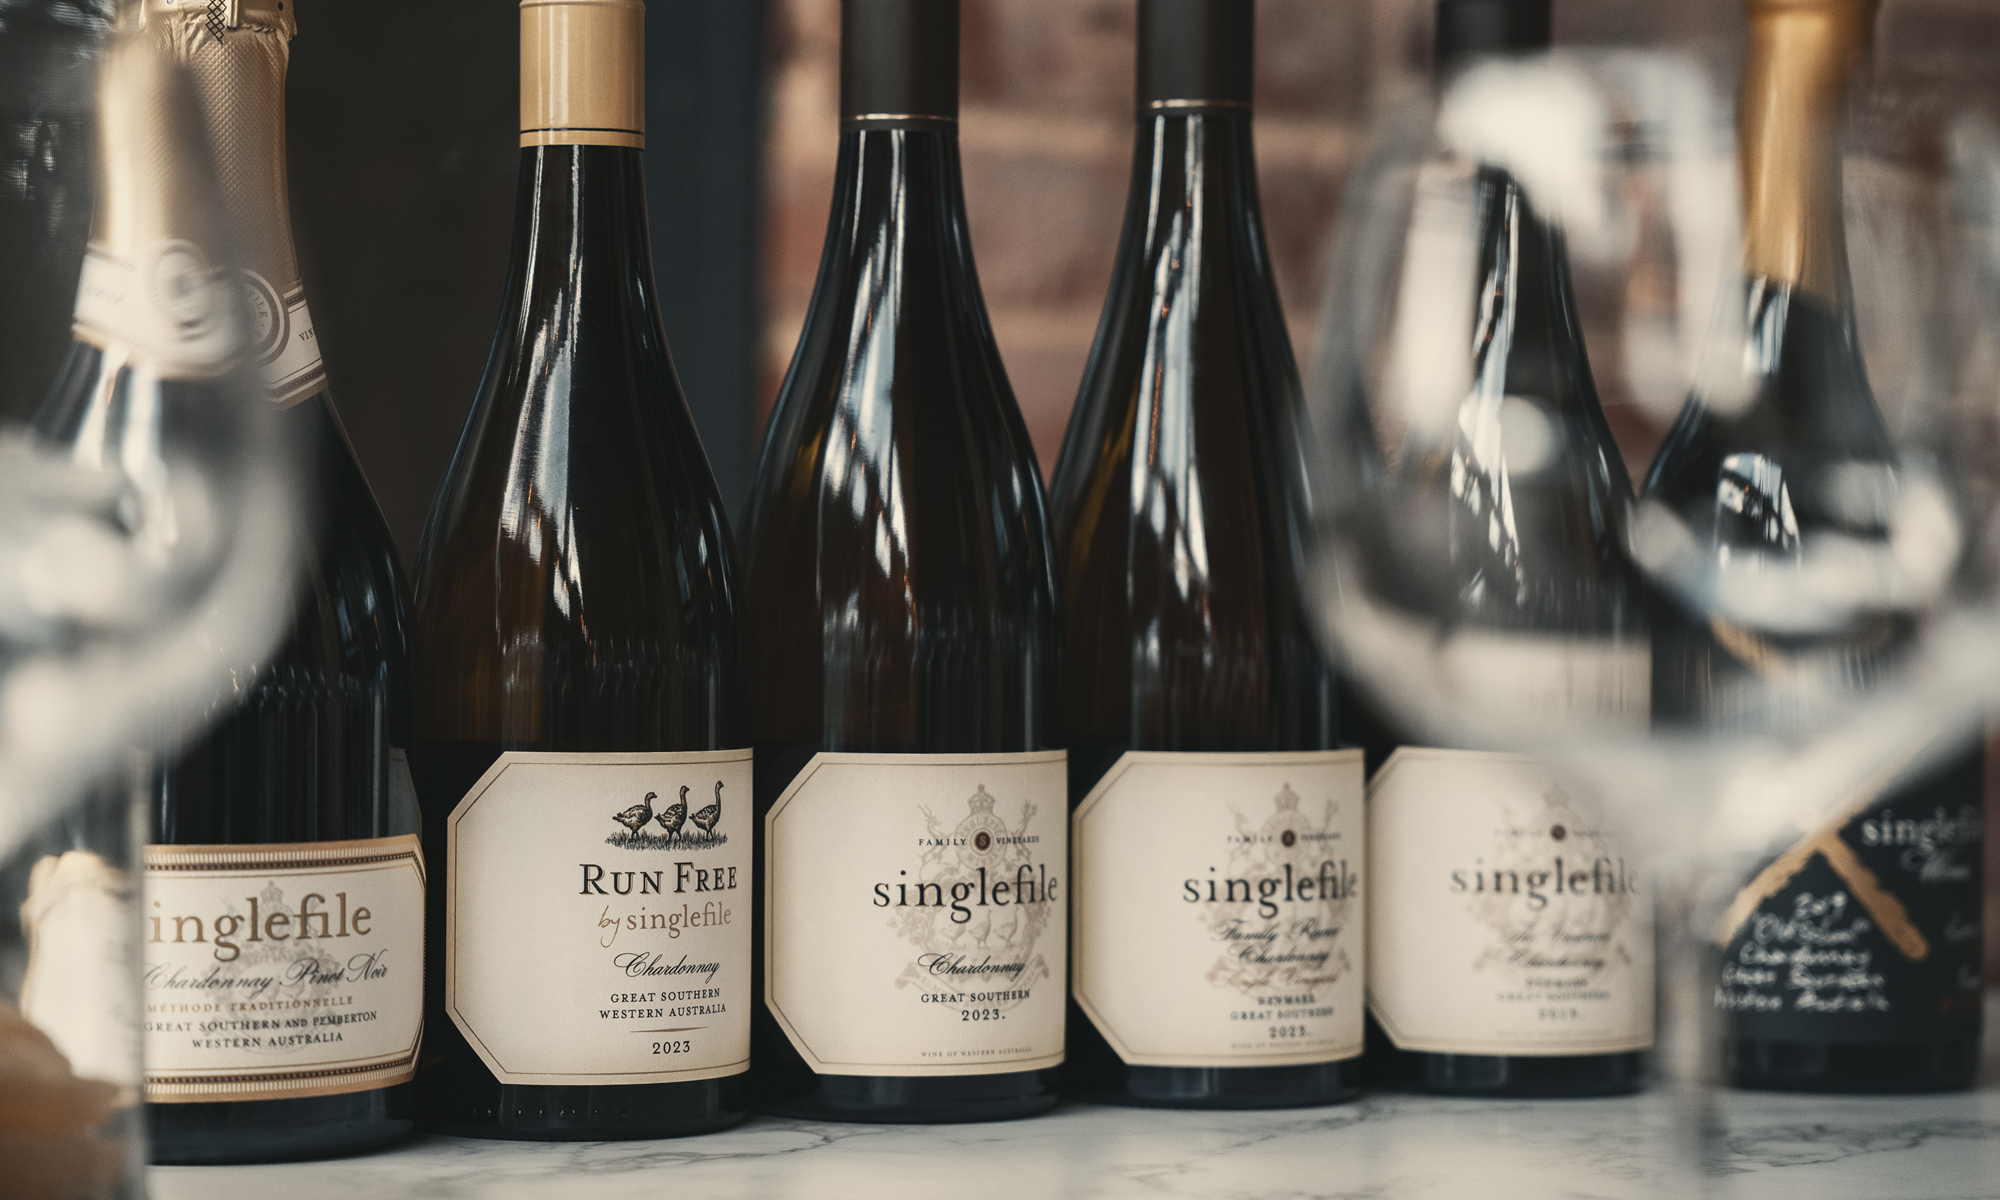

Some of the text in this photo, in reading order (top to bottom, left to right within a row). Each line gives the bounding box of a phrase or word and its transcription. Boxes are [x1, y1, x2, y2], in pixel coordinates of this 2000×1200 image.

[918, 838, 967, 846] FAMILY
[996, 835, 1040, 845] VINEYARDS
[873, 863, 1057, 924] singlefile
[1183, 859, 1358, 919] singlefile
[148, 892, 372, 962] inglefile
[598, 901, 732, 948] by singlefile
[144, 948, 389, 999] Chardonnay Pinot Noir
[613, 951, 721, 984] Chardonnay
[917, 952, 1026, 982] Chardonnay
[230, 995, 354, 1012] TRADITIONNELLE
[610, 988, 721, 1004] GREAT SOUTHERN
[921, 989, 1031, 1003] GREAT SOUTHERN
[599, 1003, 727, 1019] WESTERN AUSTRALIA
[962, 1008, 1006, 1021] 2023.
[145, 1011, 378, 1032] GREAT SOUTHERN AND PEMBERTON
[192, 1032, 343, 1049] WESTERN AUSTRALIA
[652, 1040, 691, 1055] 2023
[961, 1049, 995, 1057] WESTERN
